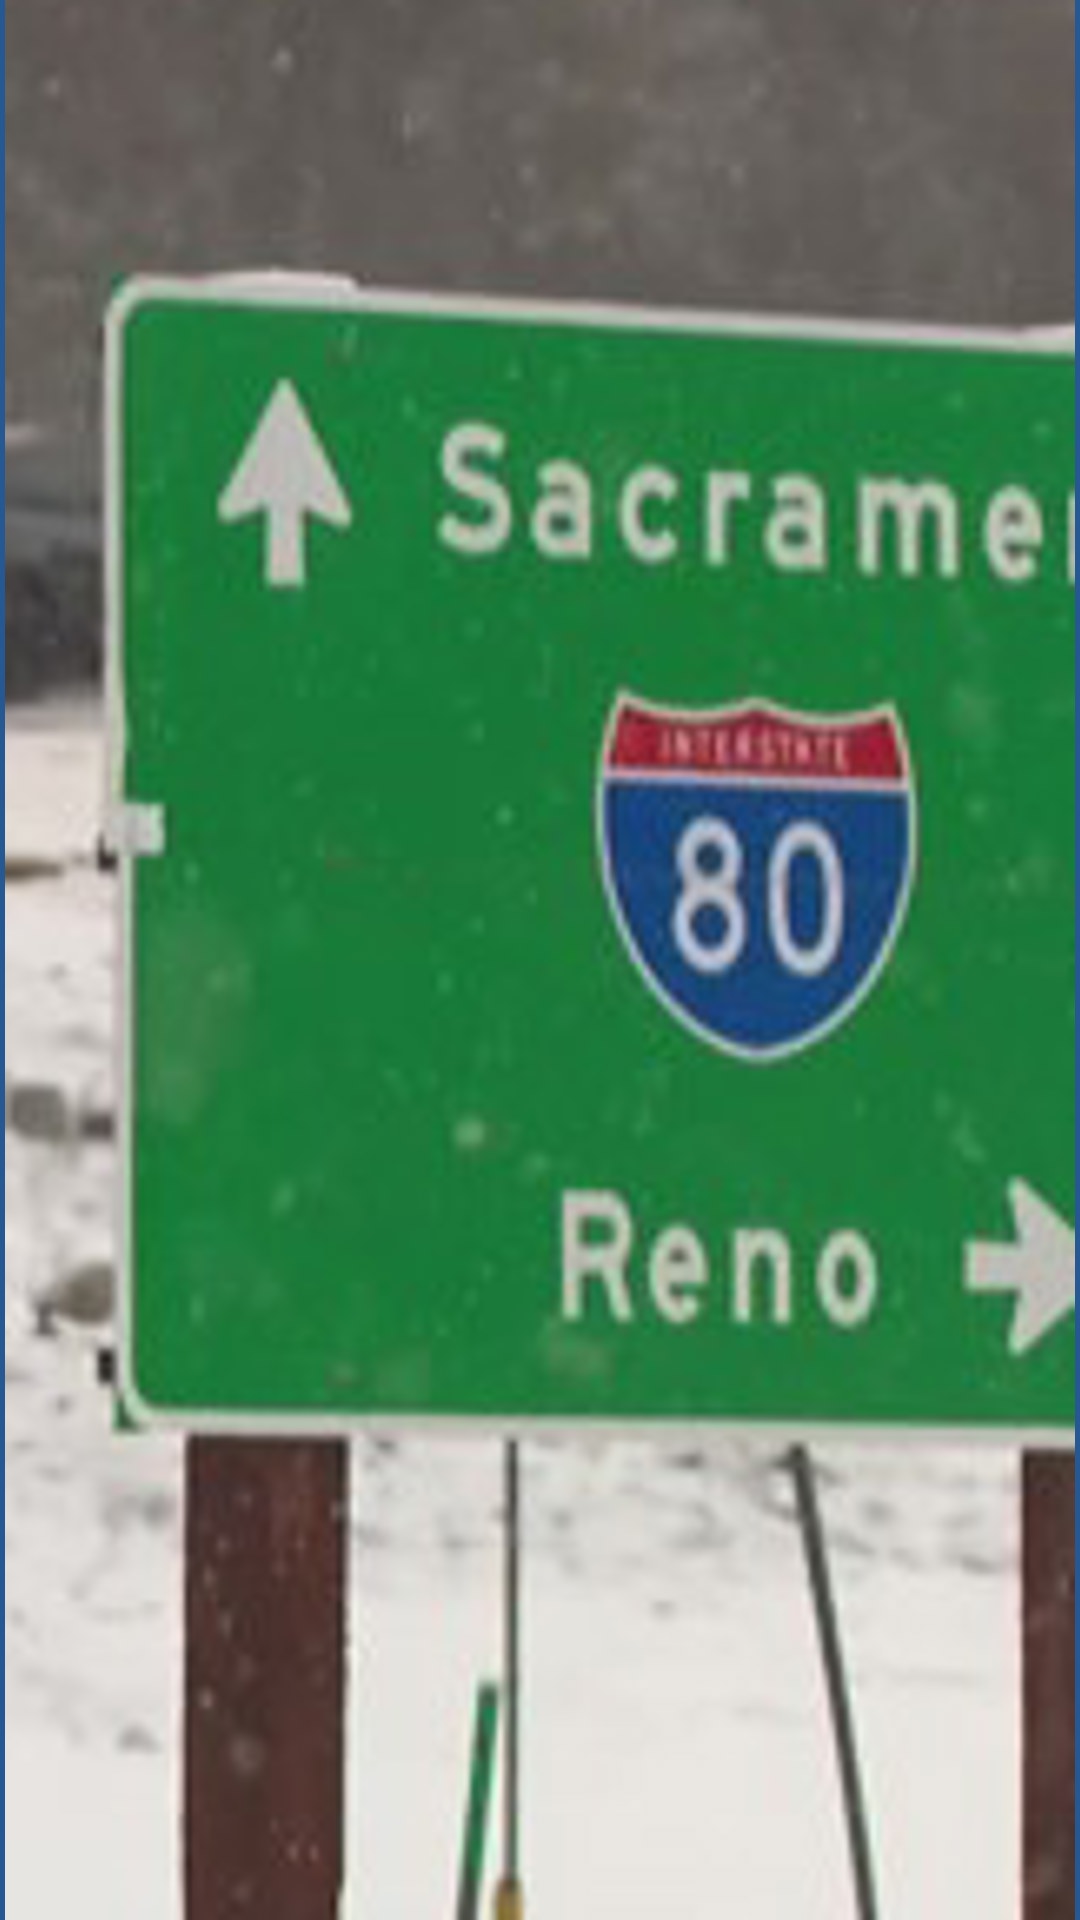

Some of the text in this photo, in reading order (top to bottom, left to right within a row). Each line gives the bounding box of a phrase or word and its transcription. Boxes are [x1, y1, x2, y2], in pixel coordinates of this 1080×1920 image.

[438, 422, 1075, 582] Sacrame
[674, 818, 844, 975] 80
[560, 1189, 878, 1325] Reno
